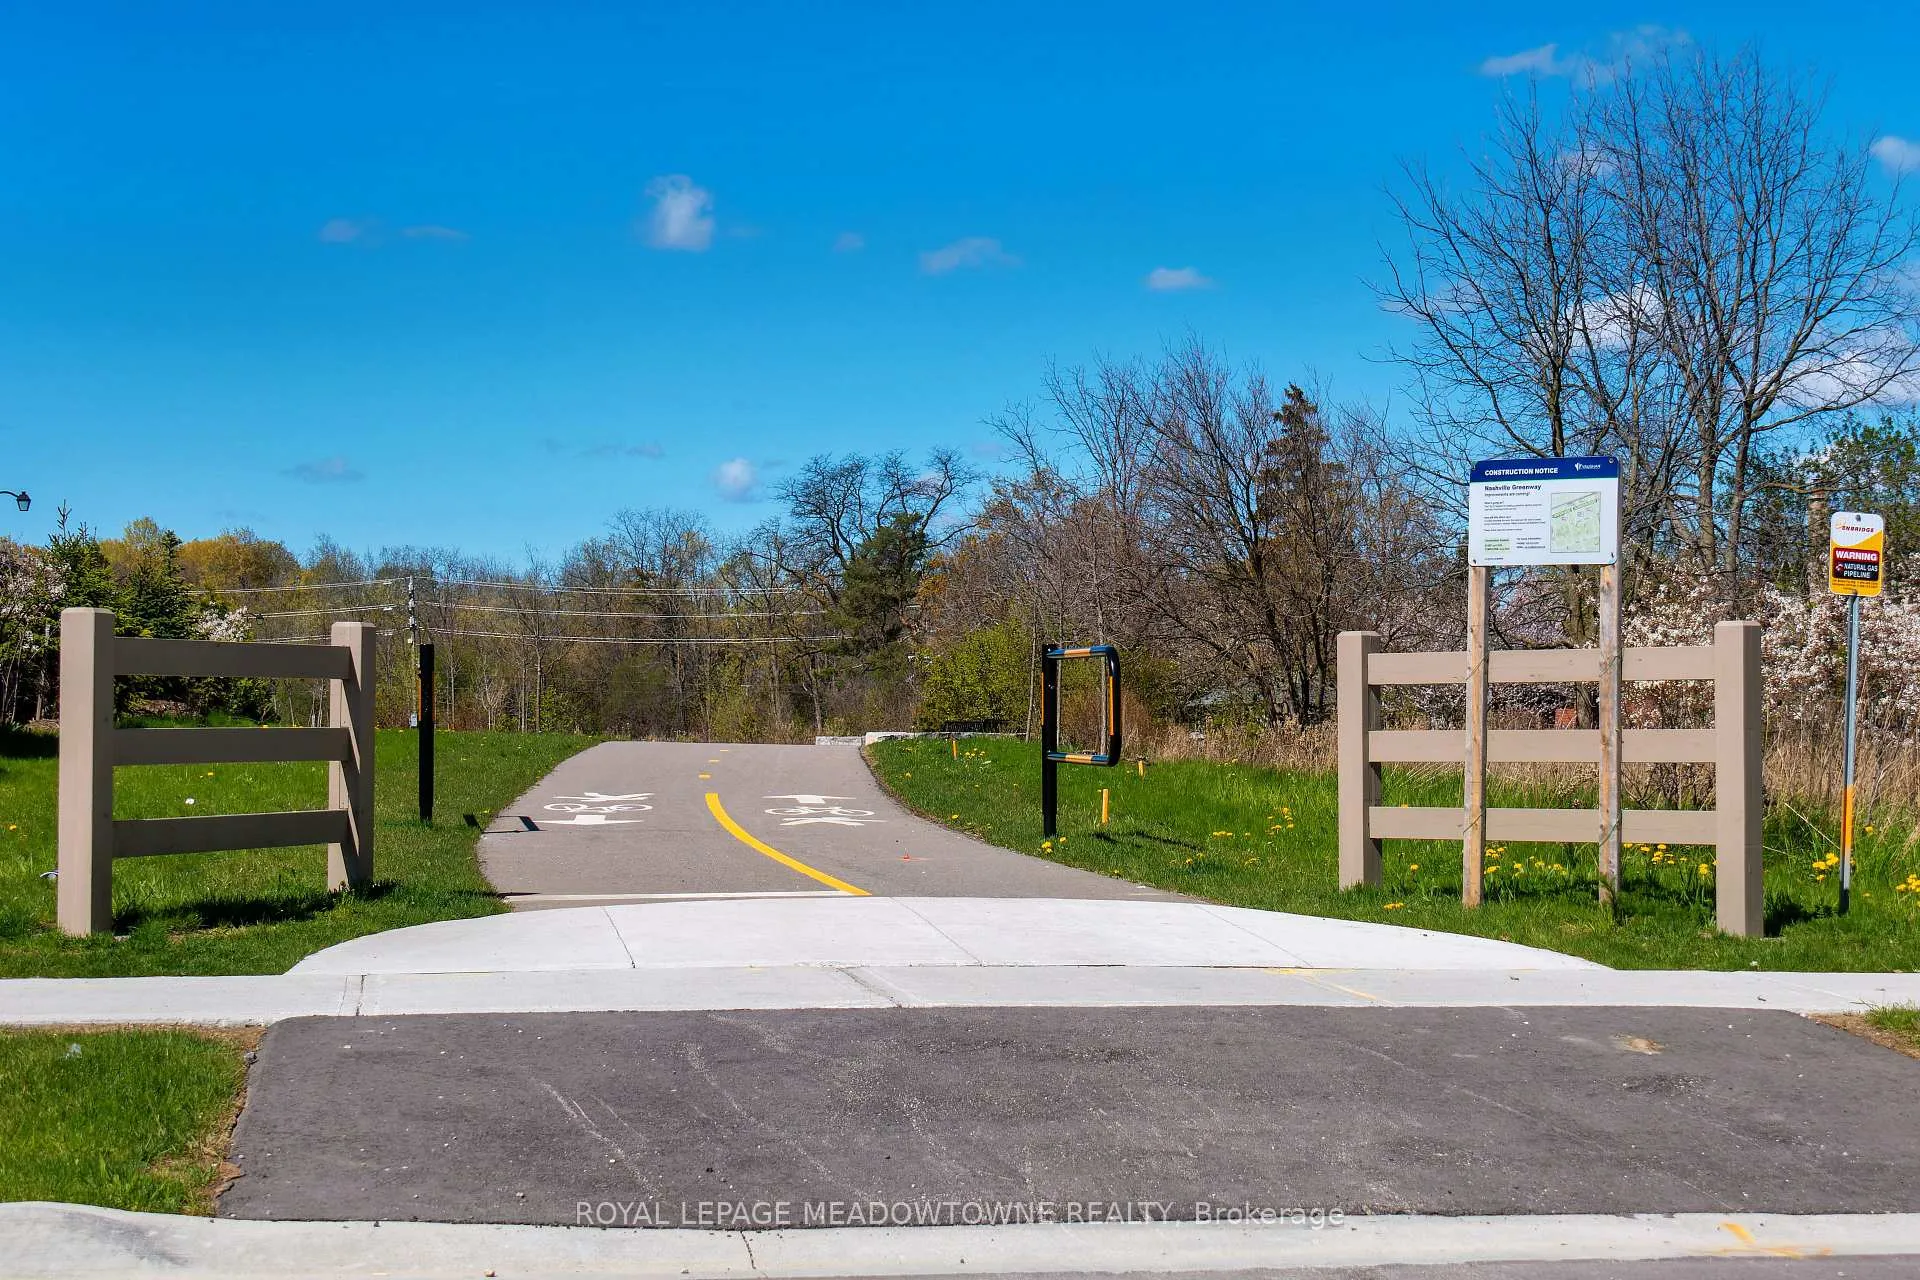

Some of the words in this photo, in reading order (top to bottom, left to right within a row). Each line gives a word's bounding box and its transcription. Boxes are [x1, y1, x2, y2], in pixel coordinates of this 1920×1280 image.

[1484, 468, 1534, 476] CONSTRUCTION
[1841, 525, 1875, 533] ENBRIDGE
[1835, 550, 1878, 561] WARNING
[1844, 563, 1867, 571] NATURAL
[1843, 570, 1871, 578] PIPELINE
